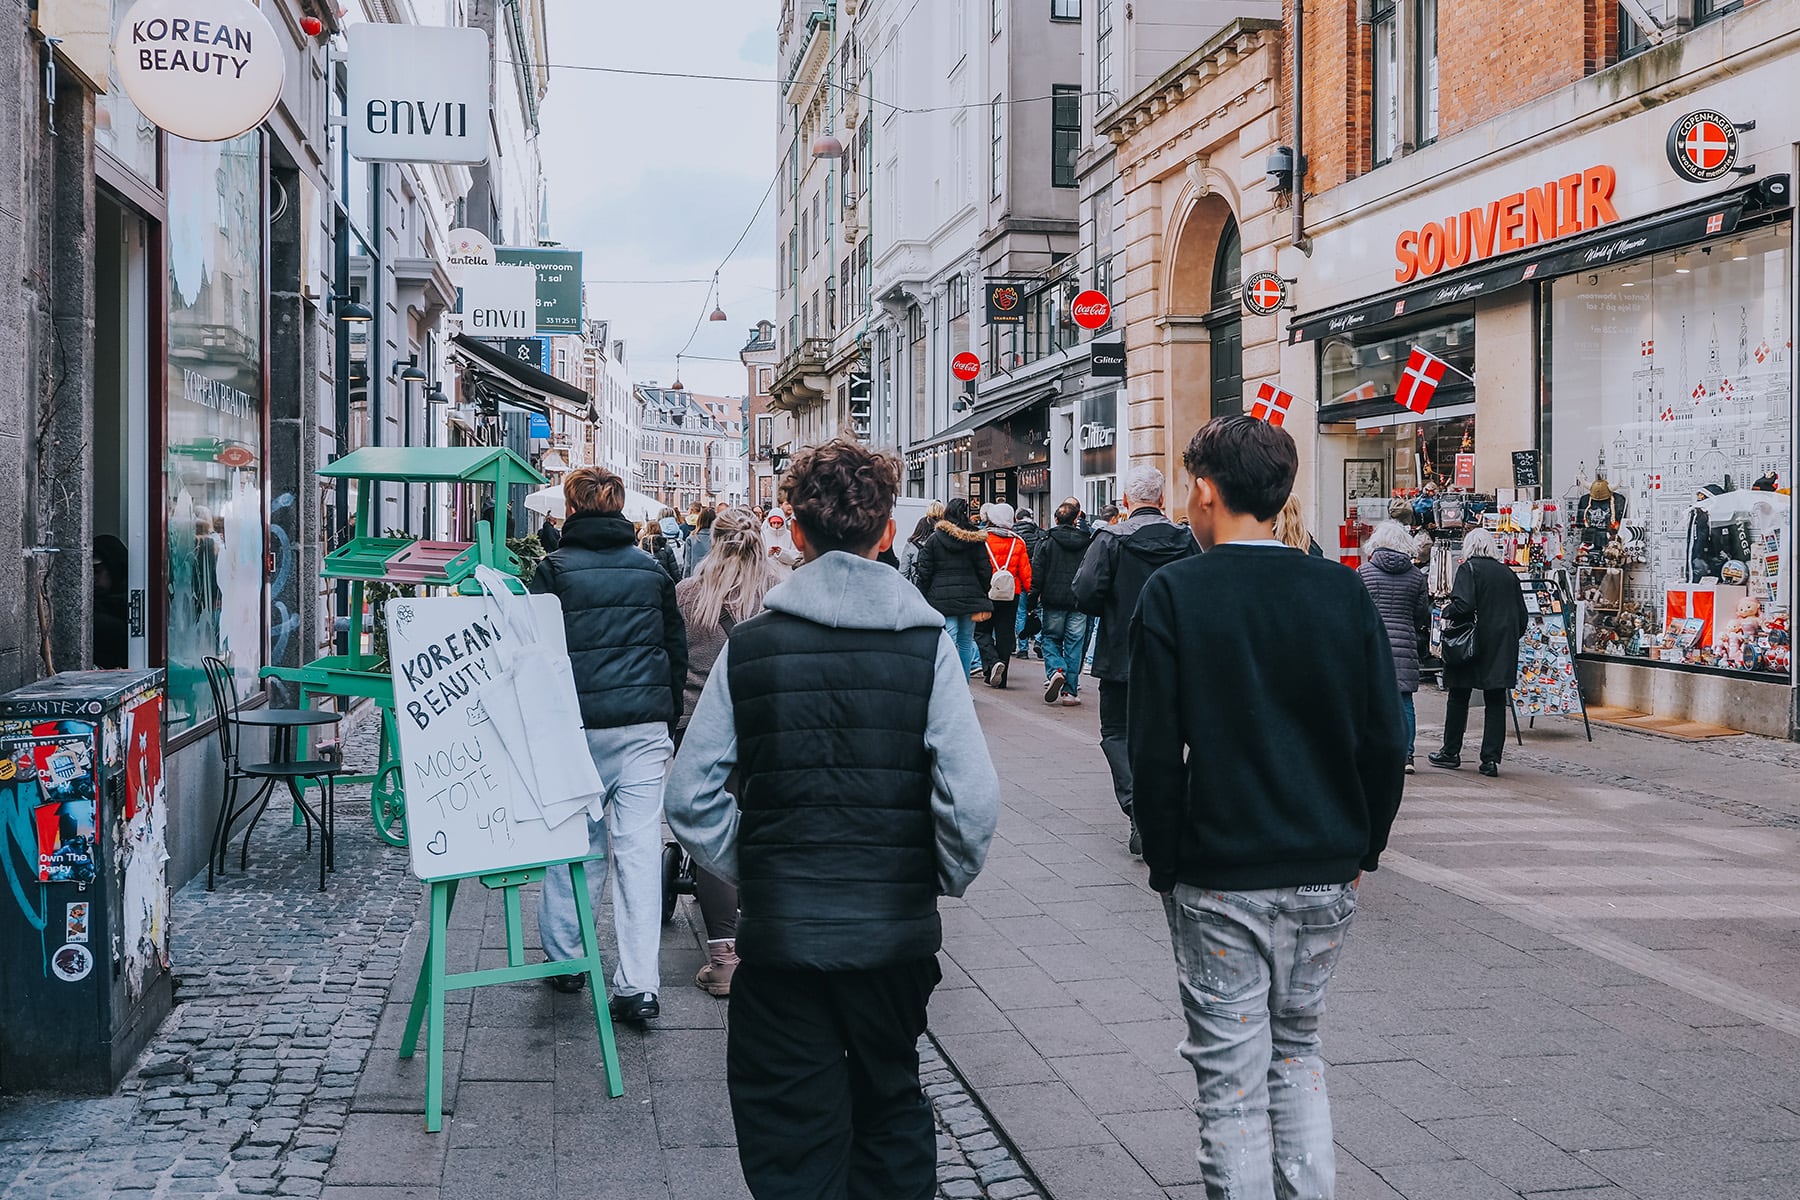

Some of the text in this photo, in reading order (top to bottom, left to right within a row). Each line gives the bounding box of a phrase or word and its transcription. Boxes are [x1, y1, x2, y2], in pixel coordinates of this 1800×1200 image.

[133, 19, 252, 53] KOREAN
[139, 49, 249, 79] BEAUTY
[1680, 112, 1734, 138] COPENHAGEN
[1697, 168, 1705, 177] of
[1395, 164, 1620, 283] SOUVENIR
[548, 274, 562, 282] sal
[1093, 355, 1123, 364] Glitter
[183, 367, 251, 421] KOREAN BEAUTY
[1080, 421, 1116, 451] Glitter
[401, 614, 502, 692] KOREAN
[406, 657, 492, 731] BEAUTY
[414, 736, 482, 788] MOGU
[426, 763, 499, 819] TOTE
[39, 852, 88, 863] Own The
[39, 864, 72, 875] Party
